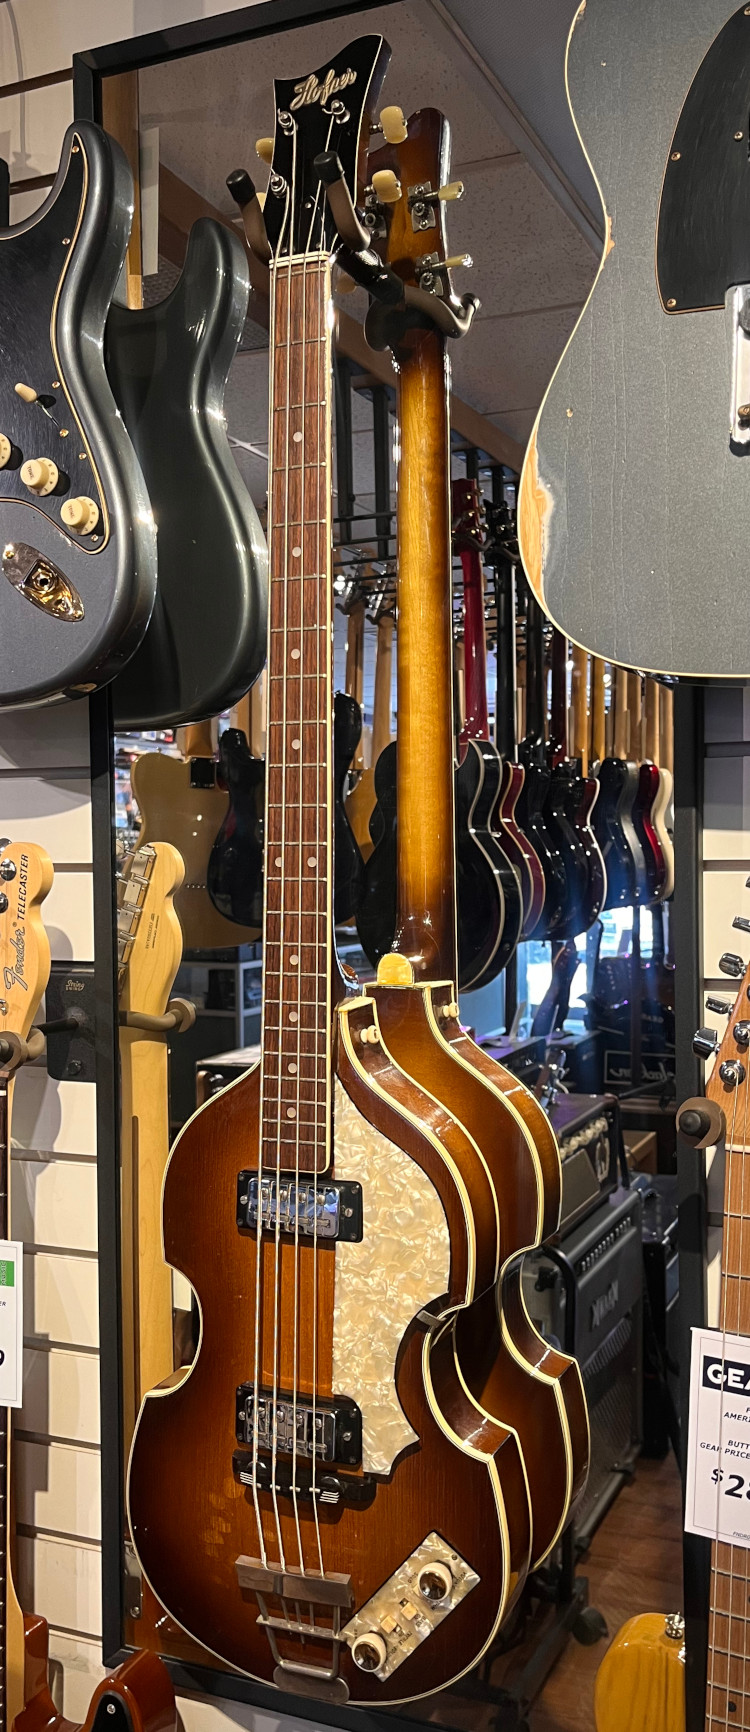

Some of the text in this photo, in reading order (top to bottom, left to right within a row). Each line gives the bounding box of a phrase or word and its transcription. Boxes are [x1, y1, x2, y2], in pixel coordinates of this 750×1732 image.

[3, 854, 29, 991] Fender TELECASTER
[707, 1363, 750, 1391] GE
